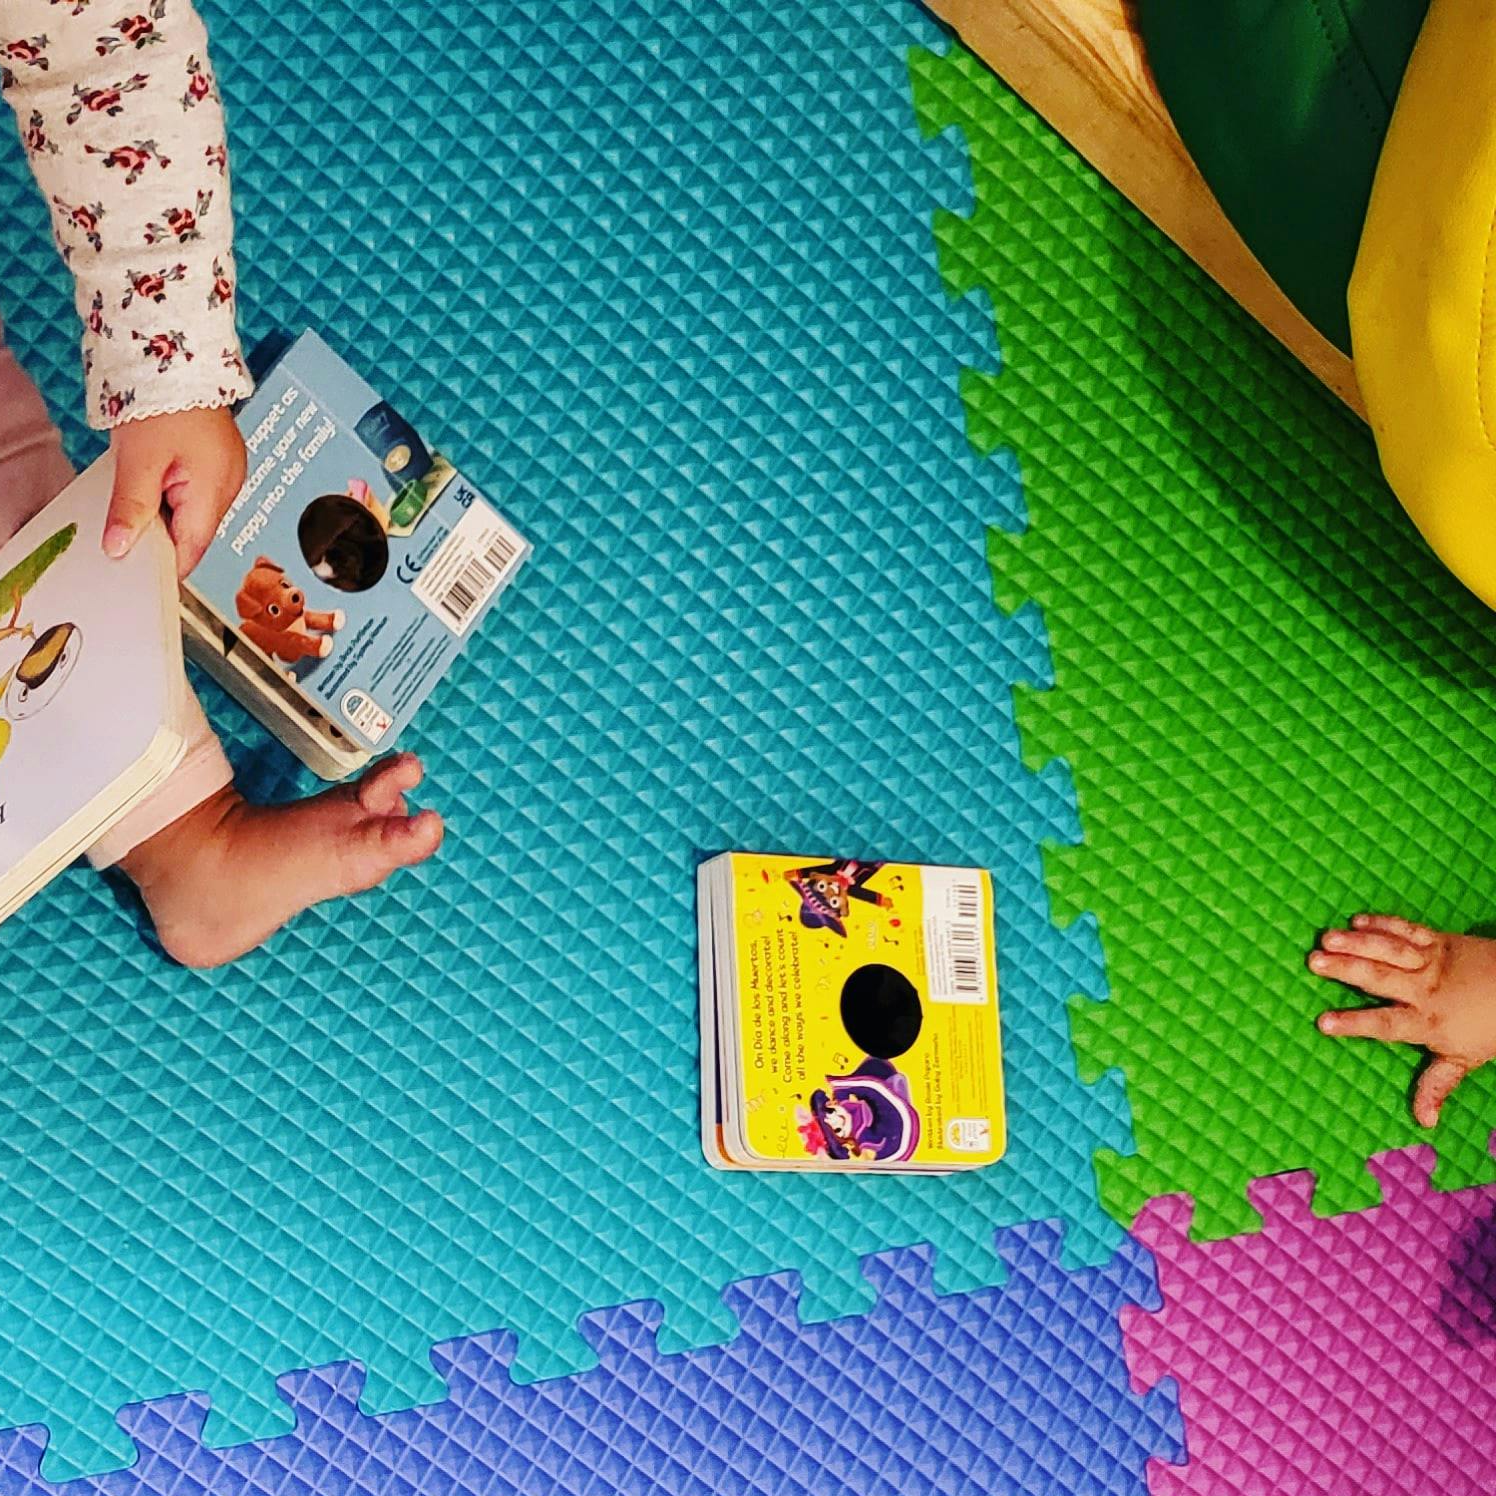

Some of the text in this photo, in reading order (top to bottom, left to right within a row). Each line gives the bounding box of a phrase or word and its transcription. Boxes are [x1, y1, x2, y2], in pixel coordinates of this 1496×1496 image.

[244, 386, 299, 454] puppet as
[270, 425, 298, 461] your
[294, 401, 318, 429] new
[229, 415, 335, 556] puppy into the family!
[751, 993, 760, 1008] los
[752, 1013, 761, 1026] de
[760, 936, 777, 1072] we dance and decorate!
[774, 928, 791, 1082] Come along and let's count
[789, 931, 805, 1079] all the ways we celebrate!
[754, 1052, 763, 1067] On
